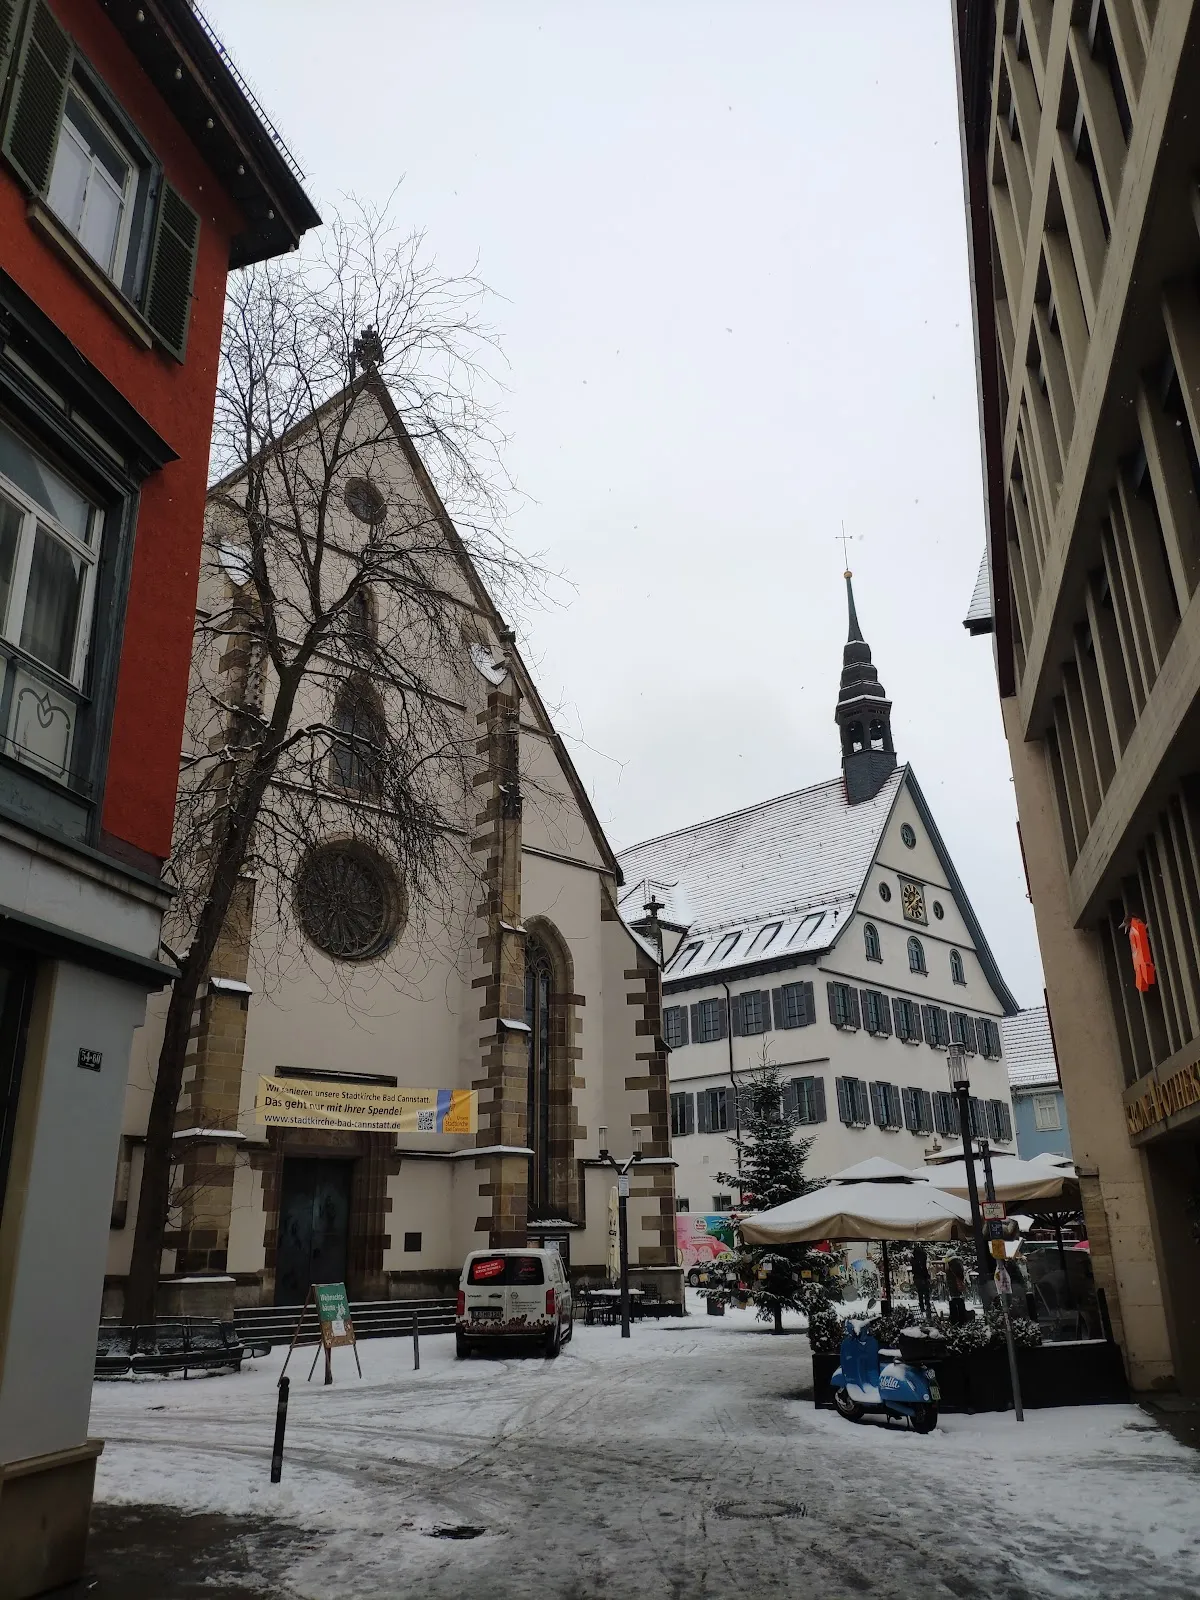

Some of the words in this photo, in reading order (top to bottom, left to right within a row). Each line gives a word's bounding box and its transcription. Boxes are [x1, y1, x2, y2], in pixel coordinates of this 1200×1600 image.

[265, 1083, 279, 1092] Wir
[281, 1086, 313, 1097] sanieren
[315, 1089, 340, 1099] unsere
[341, 1091, 380, 1102] Stadtkirche
[383, 1094, 396, 1102] Bad
[397, 1094, 431, 1104] Cannstatt.
[264, 1096, 282, 1107] Das
[284, 1099, 307, 1110] geht
[309, 1102, 325, 1111] nur
[326, 1102, 342, 1112] mit
[344, 1103, 366, 1114] Ihrer
[368, 1105, 403, 1116] Spende!
[264, 1114, 401, 1130] www.stadtkirche-bad-cannstatt.de
